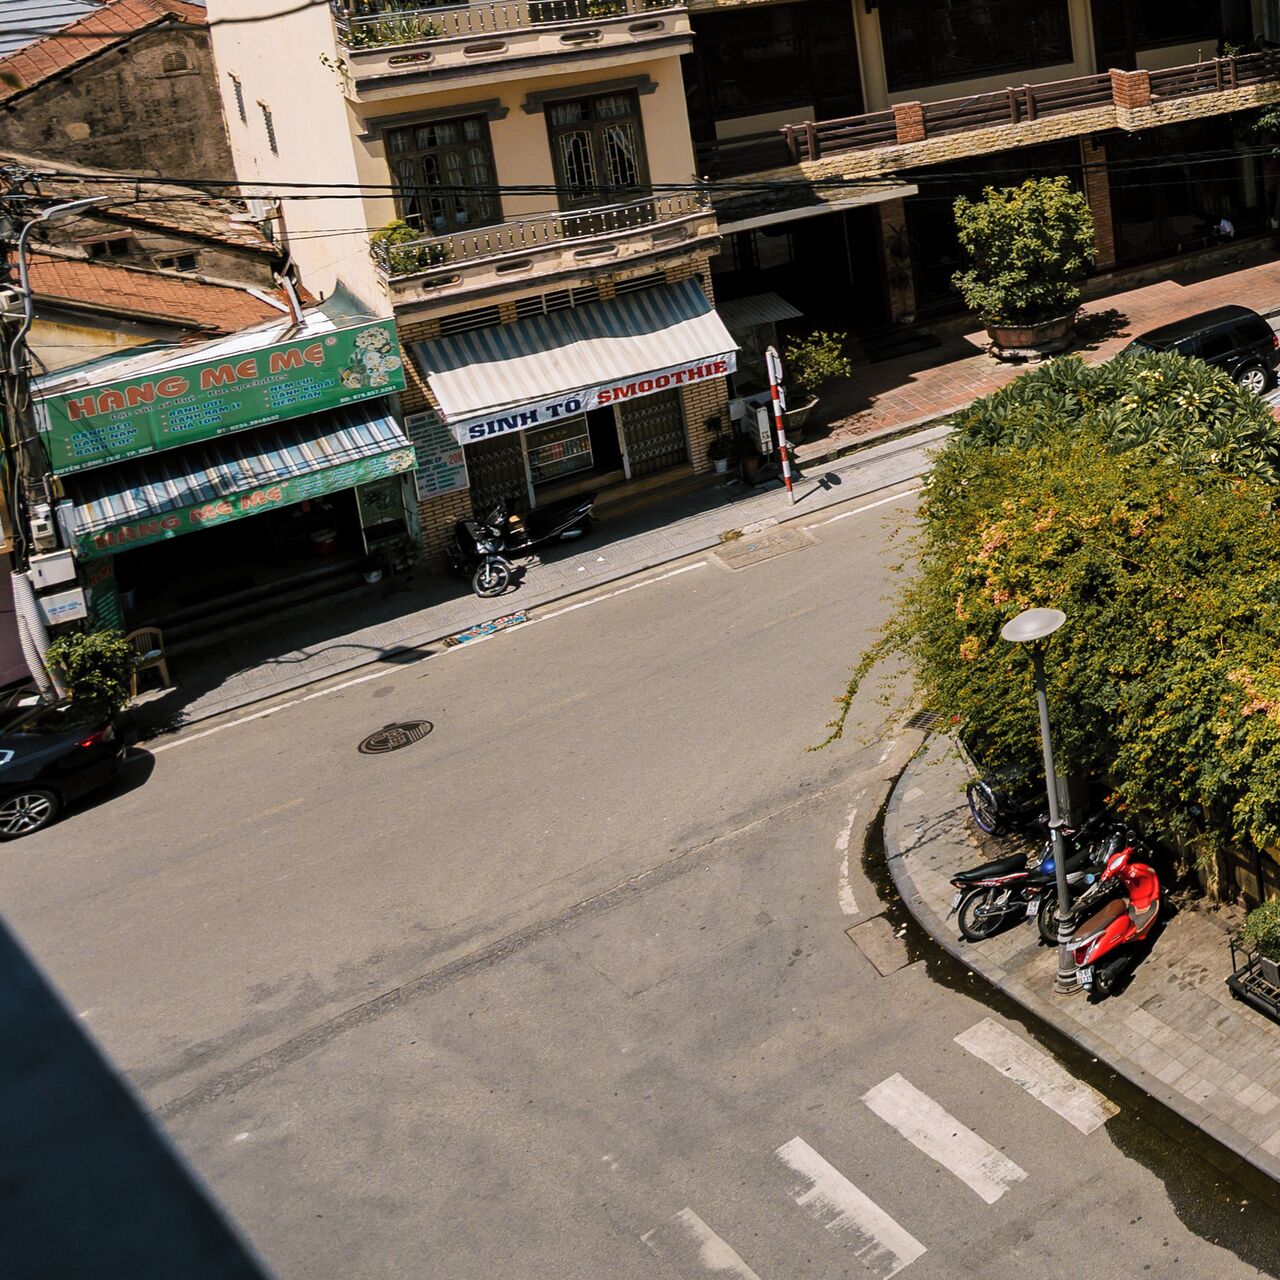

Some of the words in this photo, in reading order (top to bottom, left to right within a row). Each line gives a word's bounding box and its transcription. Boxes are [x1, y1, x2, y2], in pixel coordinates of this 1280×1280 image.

[66, 375, 190, 422] HÀNG
[200, 357, 259, 391] ME
[269, 342, 325, 374] MẸ
[468, 409, 538, 440] SINH
[546, 392, 582, 418] TỐ
[596, 360, 728, 406] SMOOTHIE
